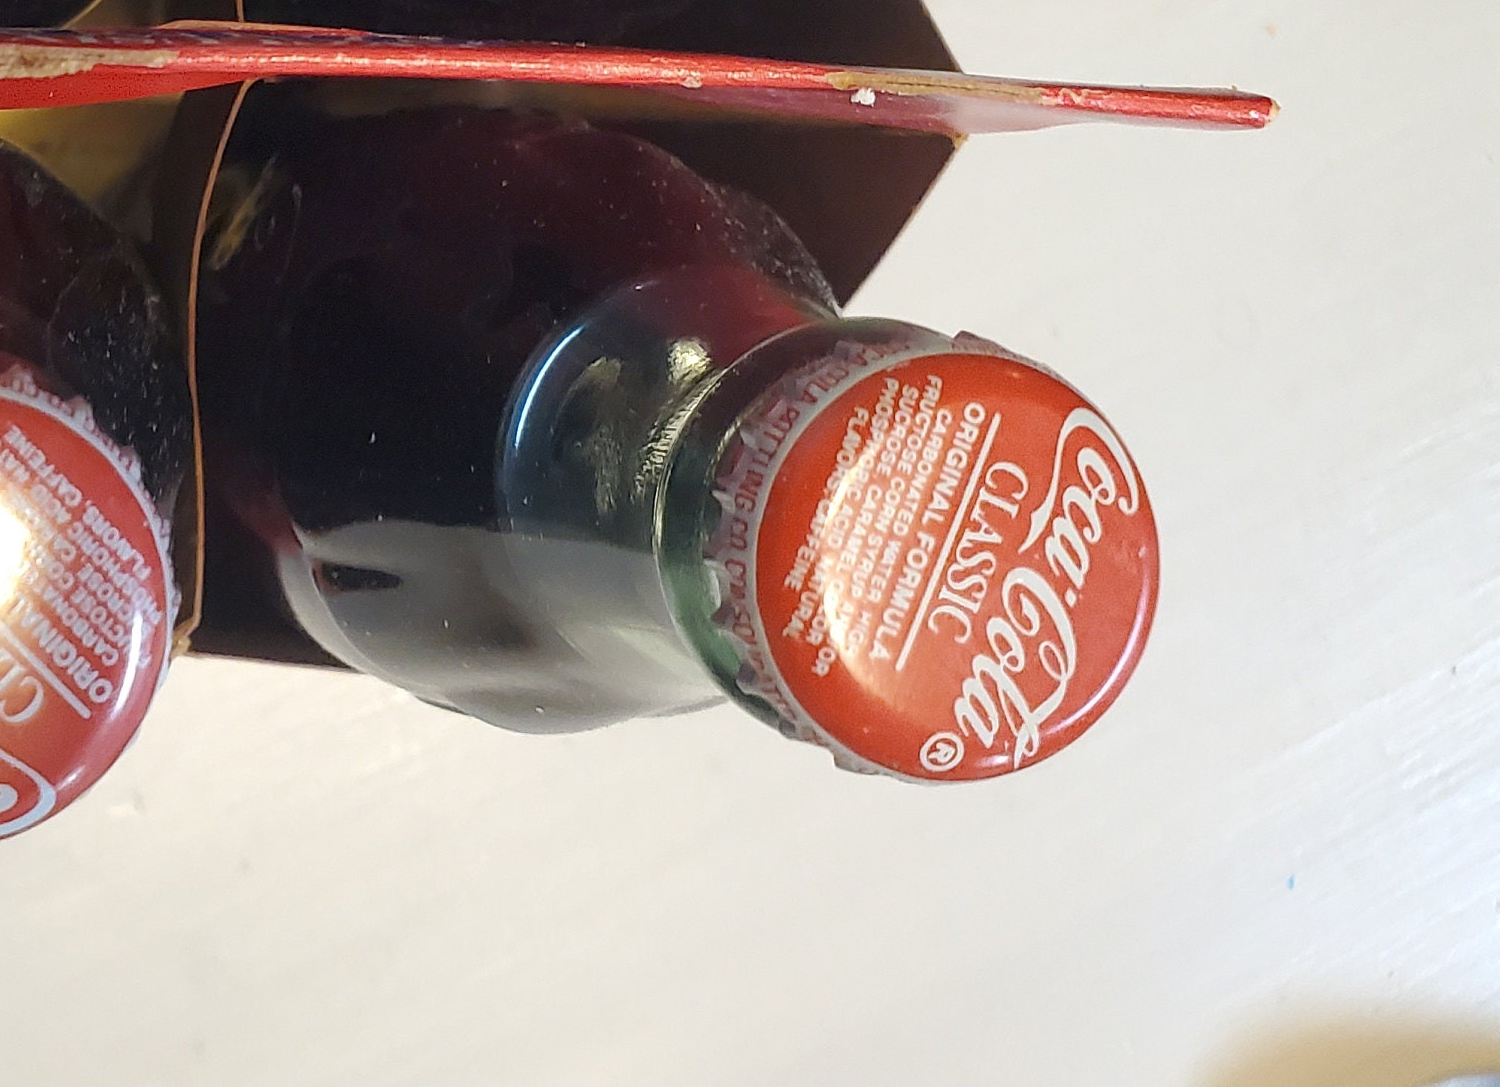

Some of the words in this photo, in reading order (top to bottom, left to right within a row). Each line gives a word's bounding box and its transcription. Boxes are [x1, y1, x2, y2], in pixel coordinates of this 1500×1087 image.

[837, 374, 906, 503] PHOSPHORIC
[889, 372, 948, 476] FRUCTOSE
[889, 407, 955, 538] CARBONATED
[917, 398, 989, 532] ORIGINAL
[833, 482, 884, 577] CARAMEL
[872, 474, 908, 533] CORN
[922, 455, 1035, 646] CLASSIC
[844, 531, 885, 600] SYRUP
[865, 528, 938, 664] FORMULA
[952, 406, 1139, 769] Coca-Cola
[2, 590, 117, 706] ORIGINAL
[67, 582, 155, 671] FUCTOSE
[809, 597, 857, 679] AN/OR
[841, 608, 873, 656] HIGH
